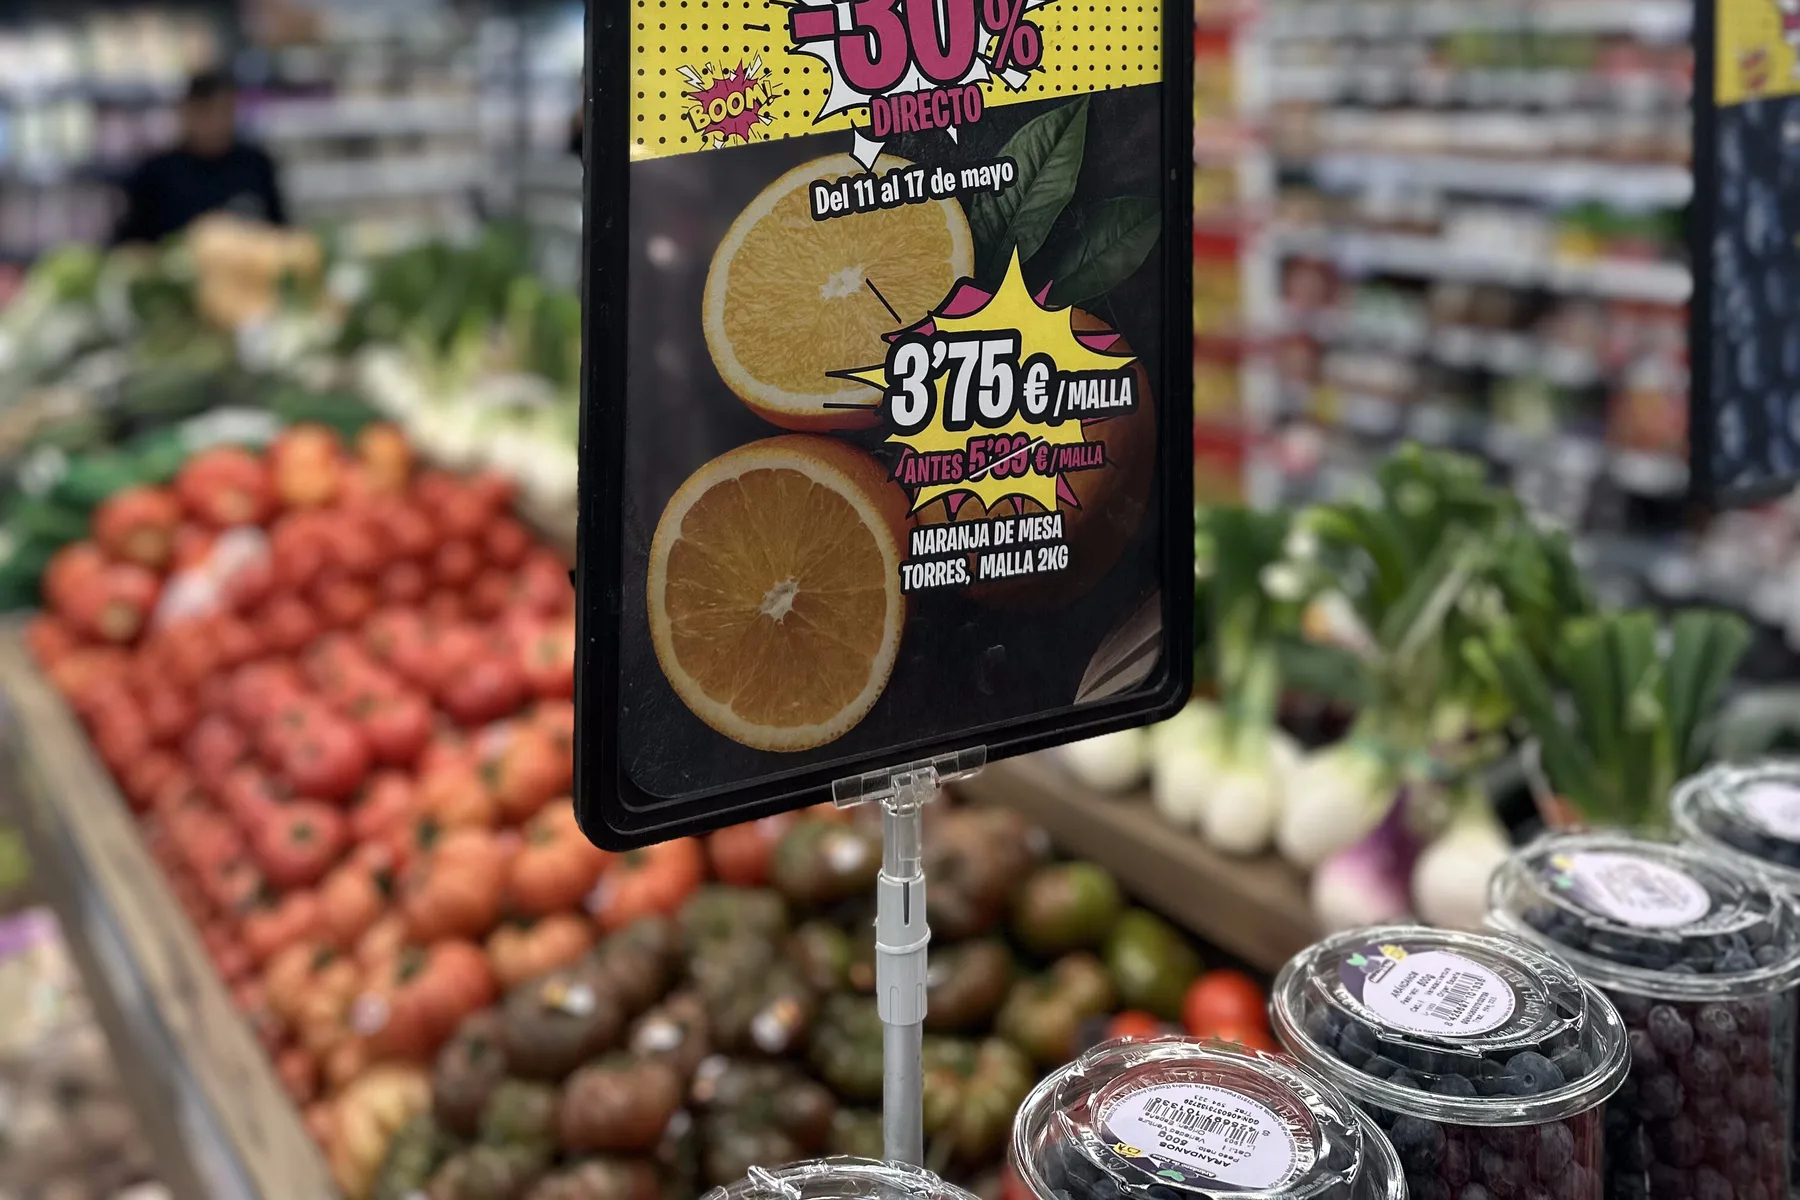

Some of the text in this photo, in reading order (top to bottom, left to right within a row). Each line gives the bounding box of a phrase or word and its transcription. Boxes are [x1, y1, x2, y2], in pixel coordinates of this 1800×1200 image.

[688, 79, 774, 133] BOOM!
[871, 84, 984, 140] DIRECTO
[815, 161, 1015, 215] Del 11 al 17 de mayo
[903, 453, 963, 486] ANTES
[911, 513, 1063, 556] NARANJA DE MESA
[902, 544, 1068, 591] TORRES, MALLA 2KG
